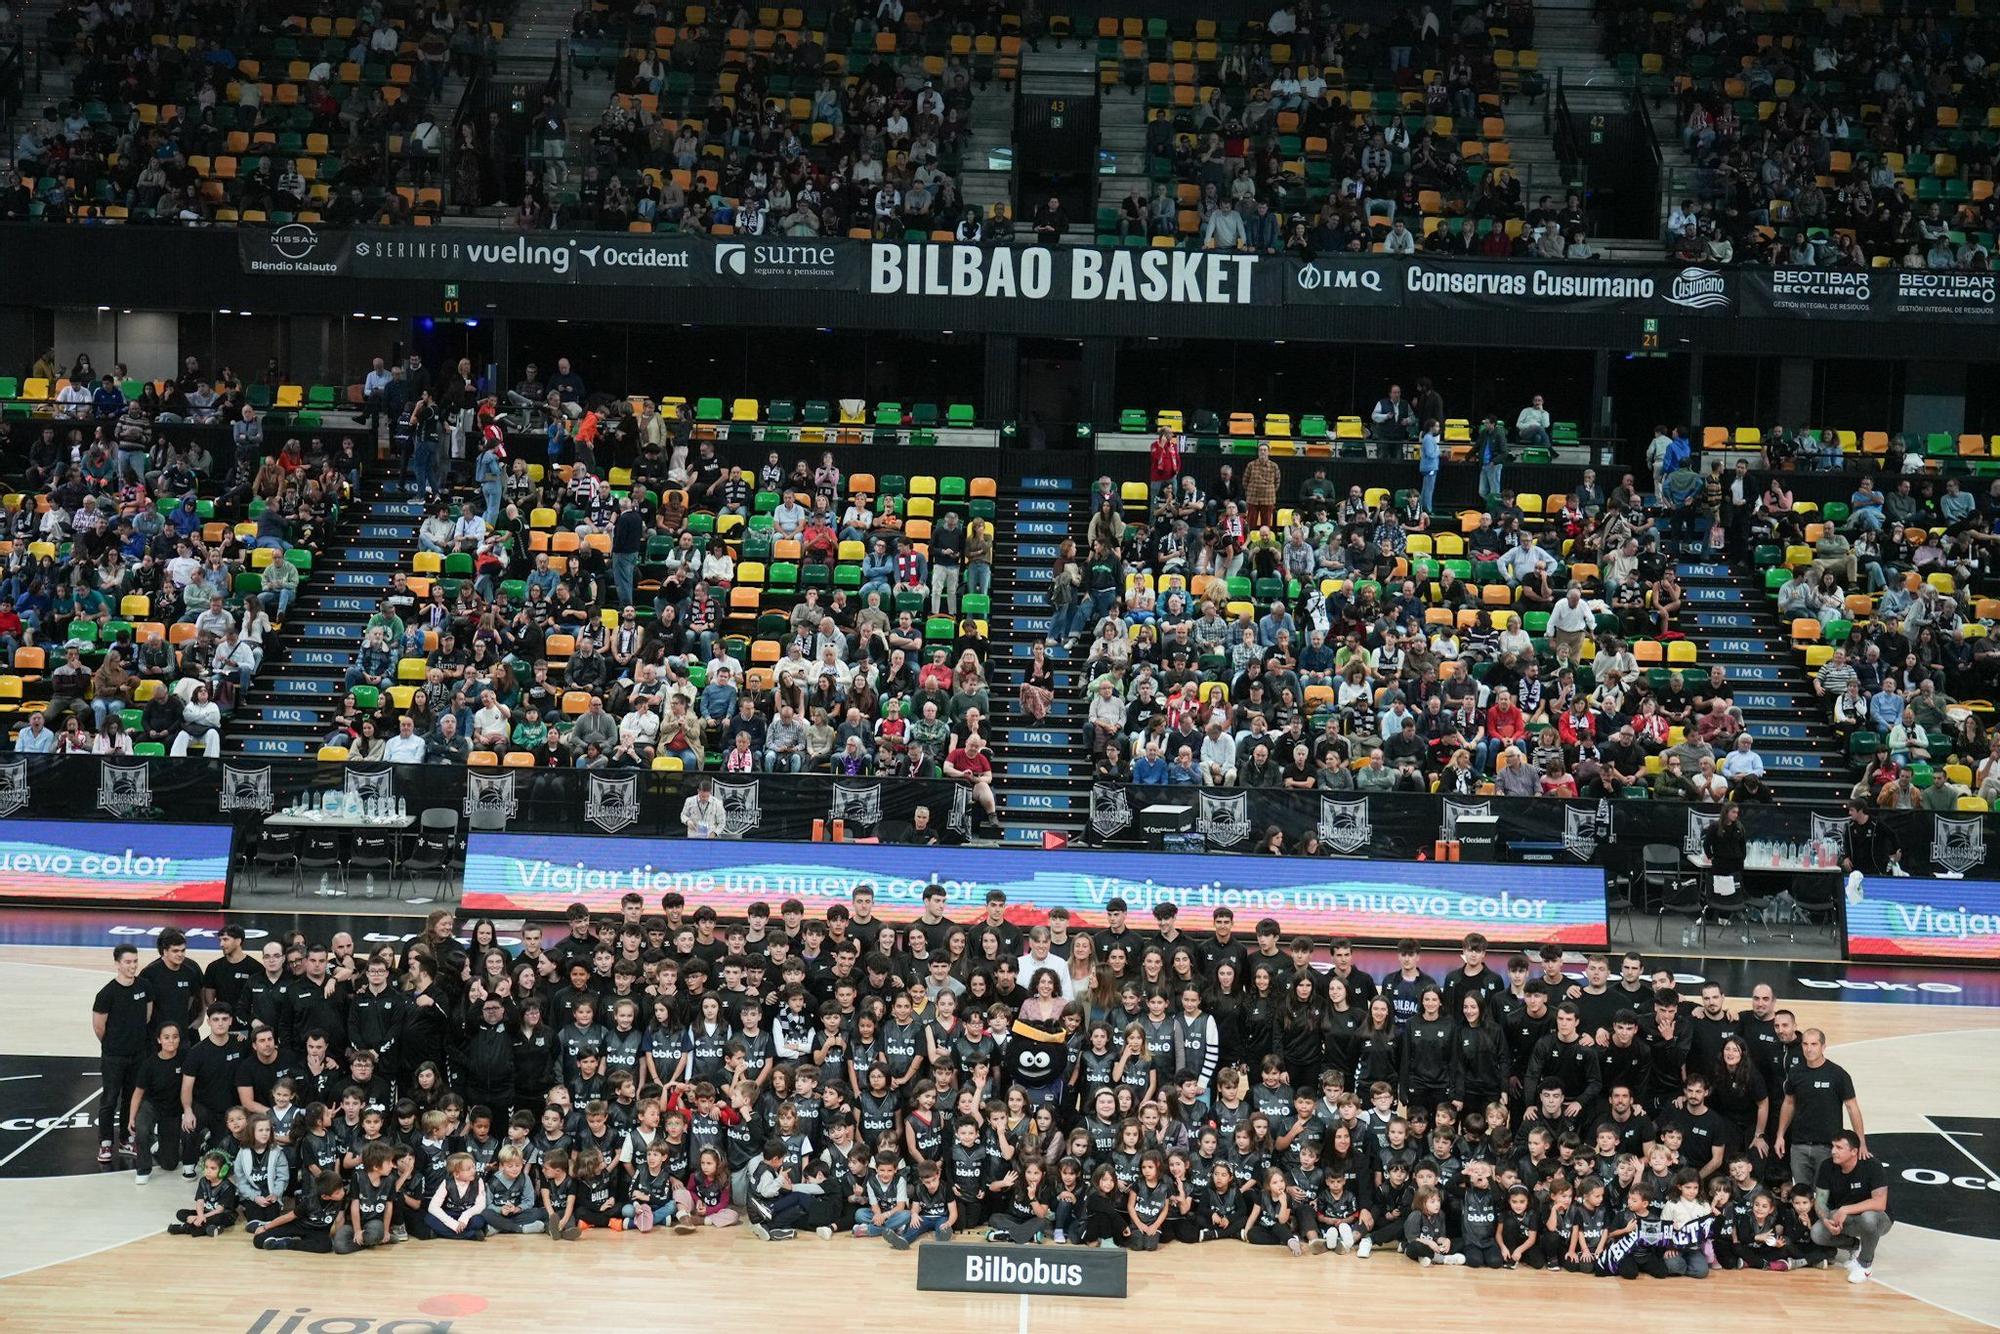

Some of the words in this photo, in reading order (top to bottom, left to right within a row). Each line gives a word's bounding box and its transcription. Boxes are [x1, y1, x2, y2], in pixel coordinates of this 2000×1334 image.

[1051, 101, 1064, 112] 43
[1590, 116, 1604, 127] 42
[271, 235, 319, 244] NISSAN
[376, 242, 460, 259] SERINFOR
[467, 236, 573, 273] vueling
[753, 243, 835, 266] surne
[603, 248, 689, 268] Occident
[251, 260, 293, 271] Blendio
[295, 261, 338, 273] Kalauto
[754, 267, 785, 277] seguros
[794, 268, 835, 278] pensiones
[870, 243, 1052, 299] BILBAO
[1071, 247, 1260, 305] BASKET
[1773, 271, 1869, 285] BEOTIBAR
[1323, 269, 1383, 292] IMQ
[1407, 266, 1527, 295] Conservas
[1533, 269, 1654, 299] Cusumano
[1899, 274, 1995, 288] BEOTIBAR
[1672, 276, 1725, 300] Cusumano
[444, 301, 459, 313] 01
[1643, 334, 1658, 347] 21
[1035, 478, 1059, 488] IMQ
[385, 505, 410, 514] IMQ
[1032, 502, 1056, 511] IMQ
[373, 527, 398, 537] IMQ
[1029, 523, 1054, 534] IMQ
[359, 550, 384, 561] IMQ
[1031, 546, 1056, 556] IMQ
[1689, 566, 1714, 576] IMQ
[349, 575, 374, 585] IMQ
[1700, 590, 1726, 600] IMQ
[334, 600, 360, 610] IMQ
[1711, 616, 1738, 626] IMQ
[319, 626, 346, 637] IMQ
[1027, 647, 1053, 657] IQ
[1723, 642, 1750, 652] IMQ
[306, 653, 334, 664] IMQ
[1736, 668, 1763, 678] IMQ
[289, 681, 318, 692] IMQ
[1748, 696, 1776, 707] IMQ
[273, 710, 301, 721] IMQ
[1762, 725, 1790, 736] IMQ
[1024, 733, 1052, 744] IMQ
[259, 741, 288, 752] IMQ
[1775, 756, 1805, 767] IMQ
[1023, 764, 1052, 775] IMQ
[1022, 796, 1052, 807] IMQ
[80, 849, 171, 876] color
[515, 861, 624, 895] Viajar
[630, 864, 715, 894] tiene
[725, 872, 767, 894] un
[1085, 878, 1194, 914] Viajar
[1200, 881, 1284, 910] tiene
[1294, 891, 1337, 913] un
[1347, 892, 1449, 917] nuevo
[1458, 891, 1548, 919] color
[966, 1256, 1083, 1286] Bilbobus
